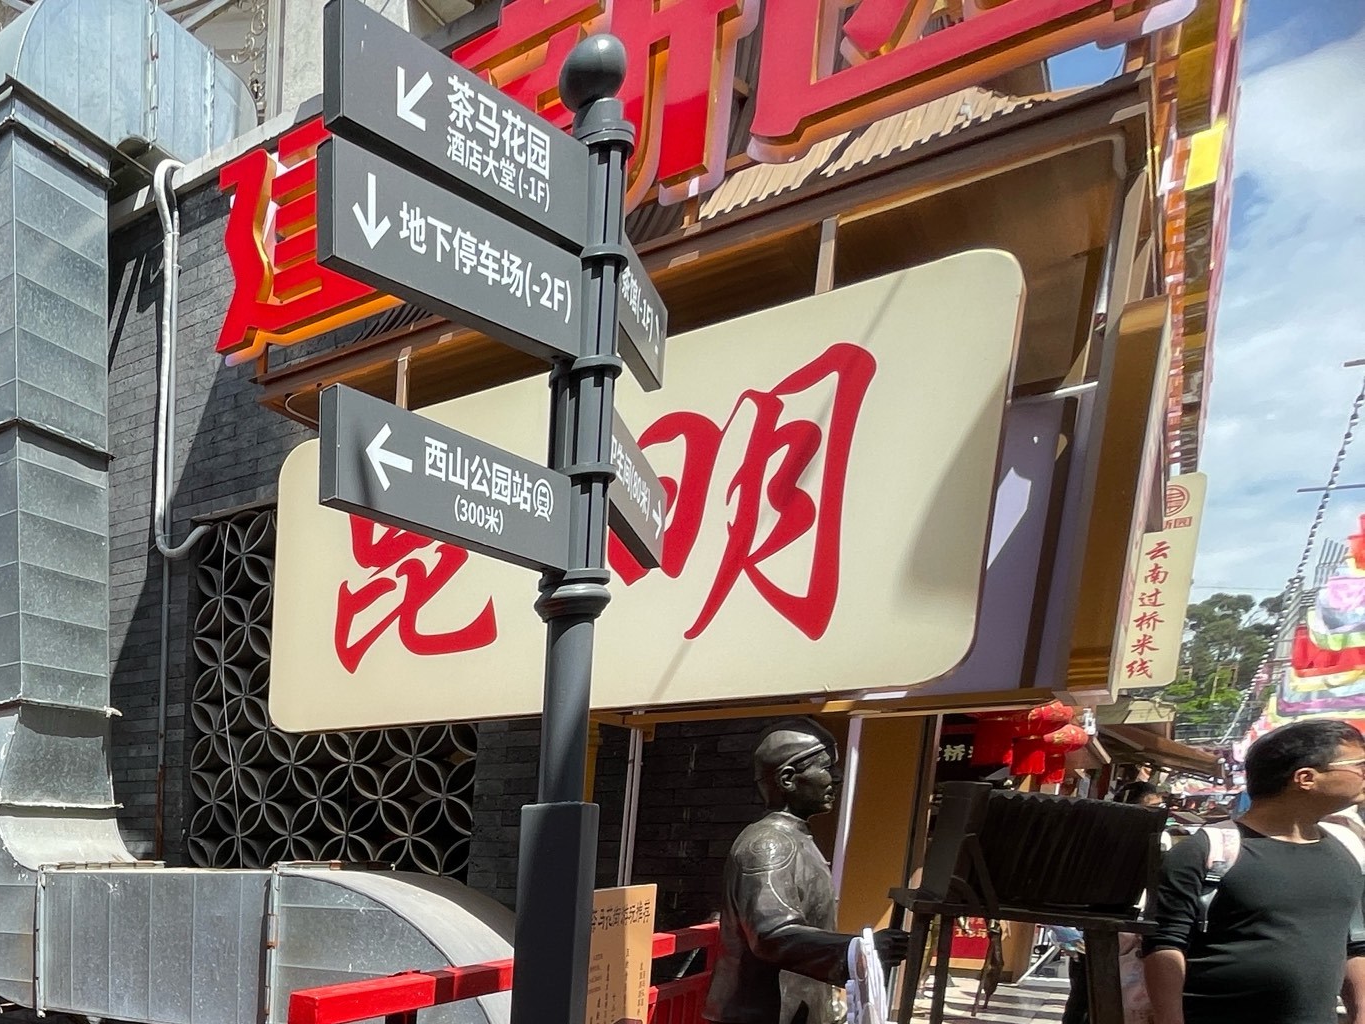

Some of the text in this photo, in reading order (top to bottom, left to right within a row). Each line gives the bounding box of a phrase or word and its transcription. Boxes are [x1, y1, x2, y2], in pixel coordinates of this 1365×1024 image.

[446, 126, 551, 213] 酒店大堂(-1F)
[447, 75, 551, 180] 茶马花园
[398, 201, 573, 324] 地下停车场(-2F)
[424, 435, 532, 513] 西山公园站
[454, 494, 504, 536] (300米)
[1125, 540, 1172, 680] 云南过桥米线
